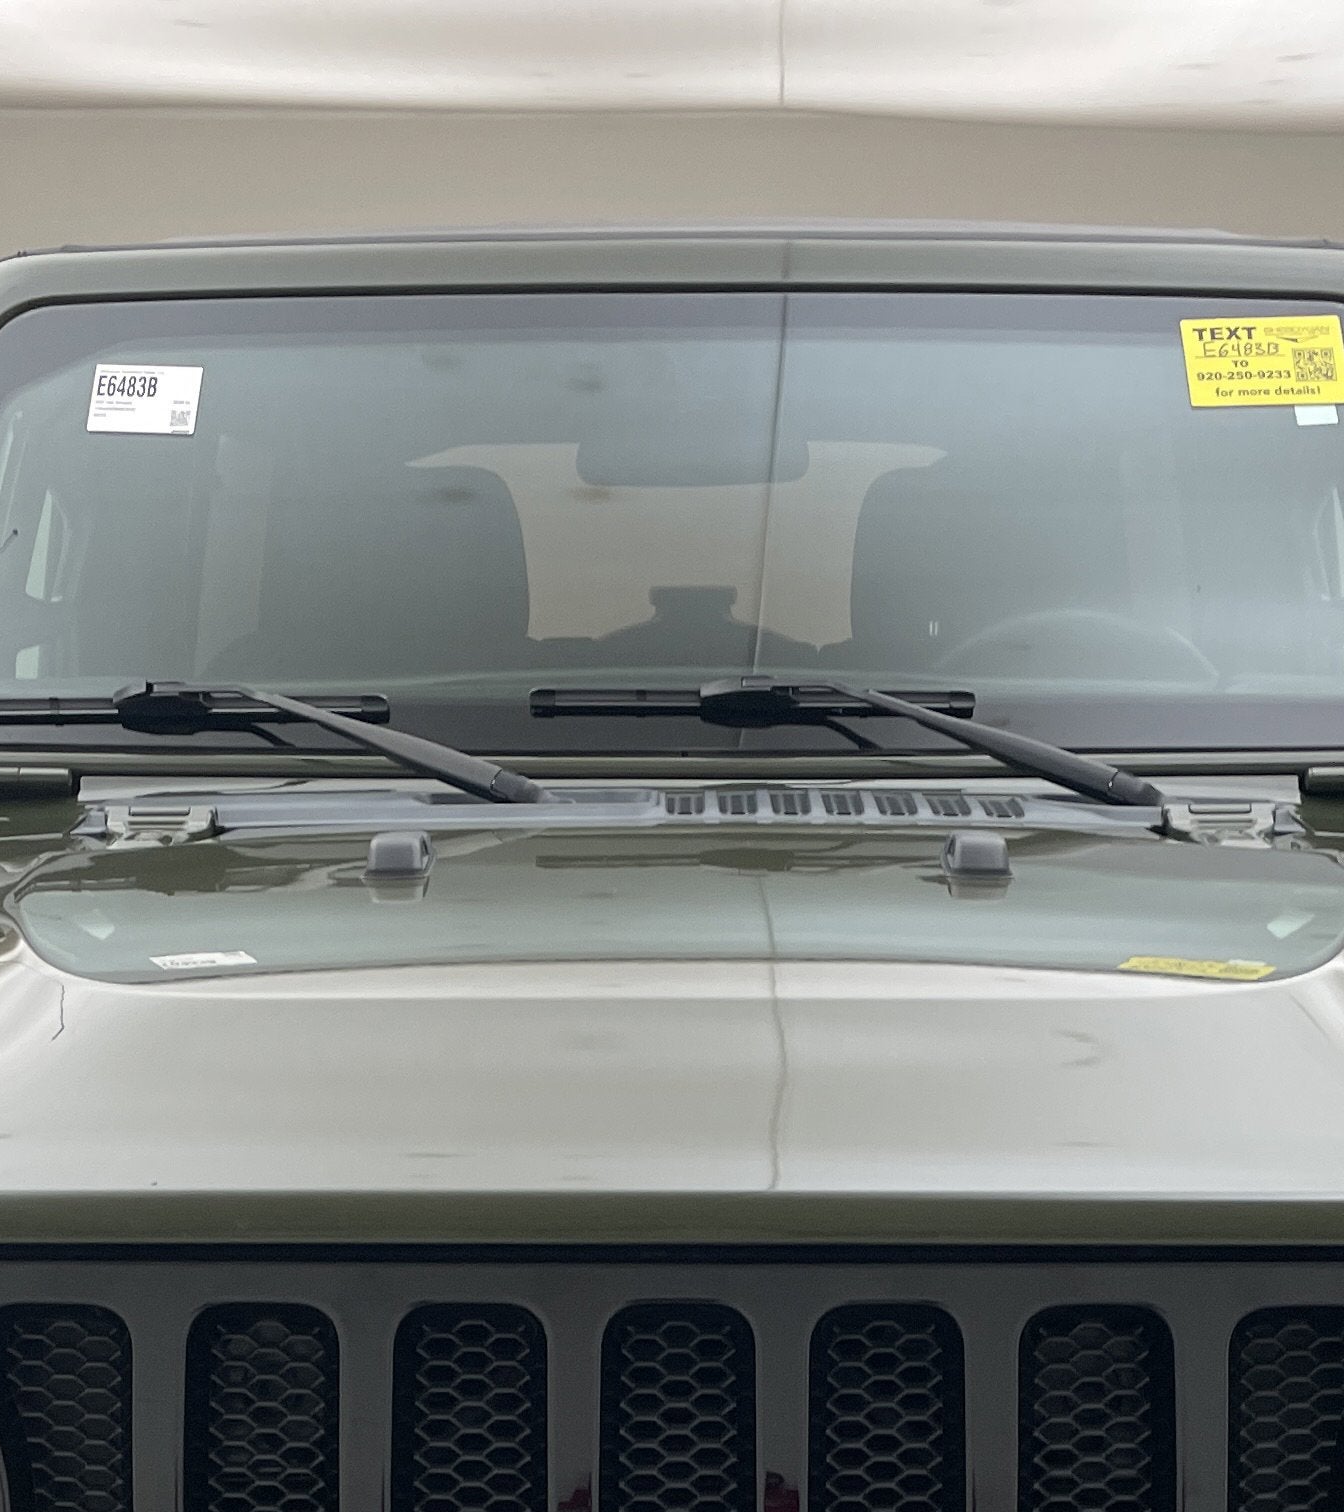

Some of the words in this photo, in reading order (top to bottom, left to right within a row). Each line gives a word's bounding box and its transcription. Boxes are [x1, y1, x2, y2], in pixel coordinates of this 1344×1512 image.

[1192, 326, 1257, 341] TEXT
[1202, 341, 1280, 358] E6483B
[1231, 359, 1249, 368] TO
[96, 375, 158, 398] E6483B
[1215, 387, 1234, 398] for
[1238, 388, 1271, 397] more
[1274, 385, 1321, 396] details!
